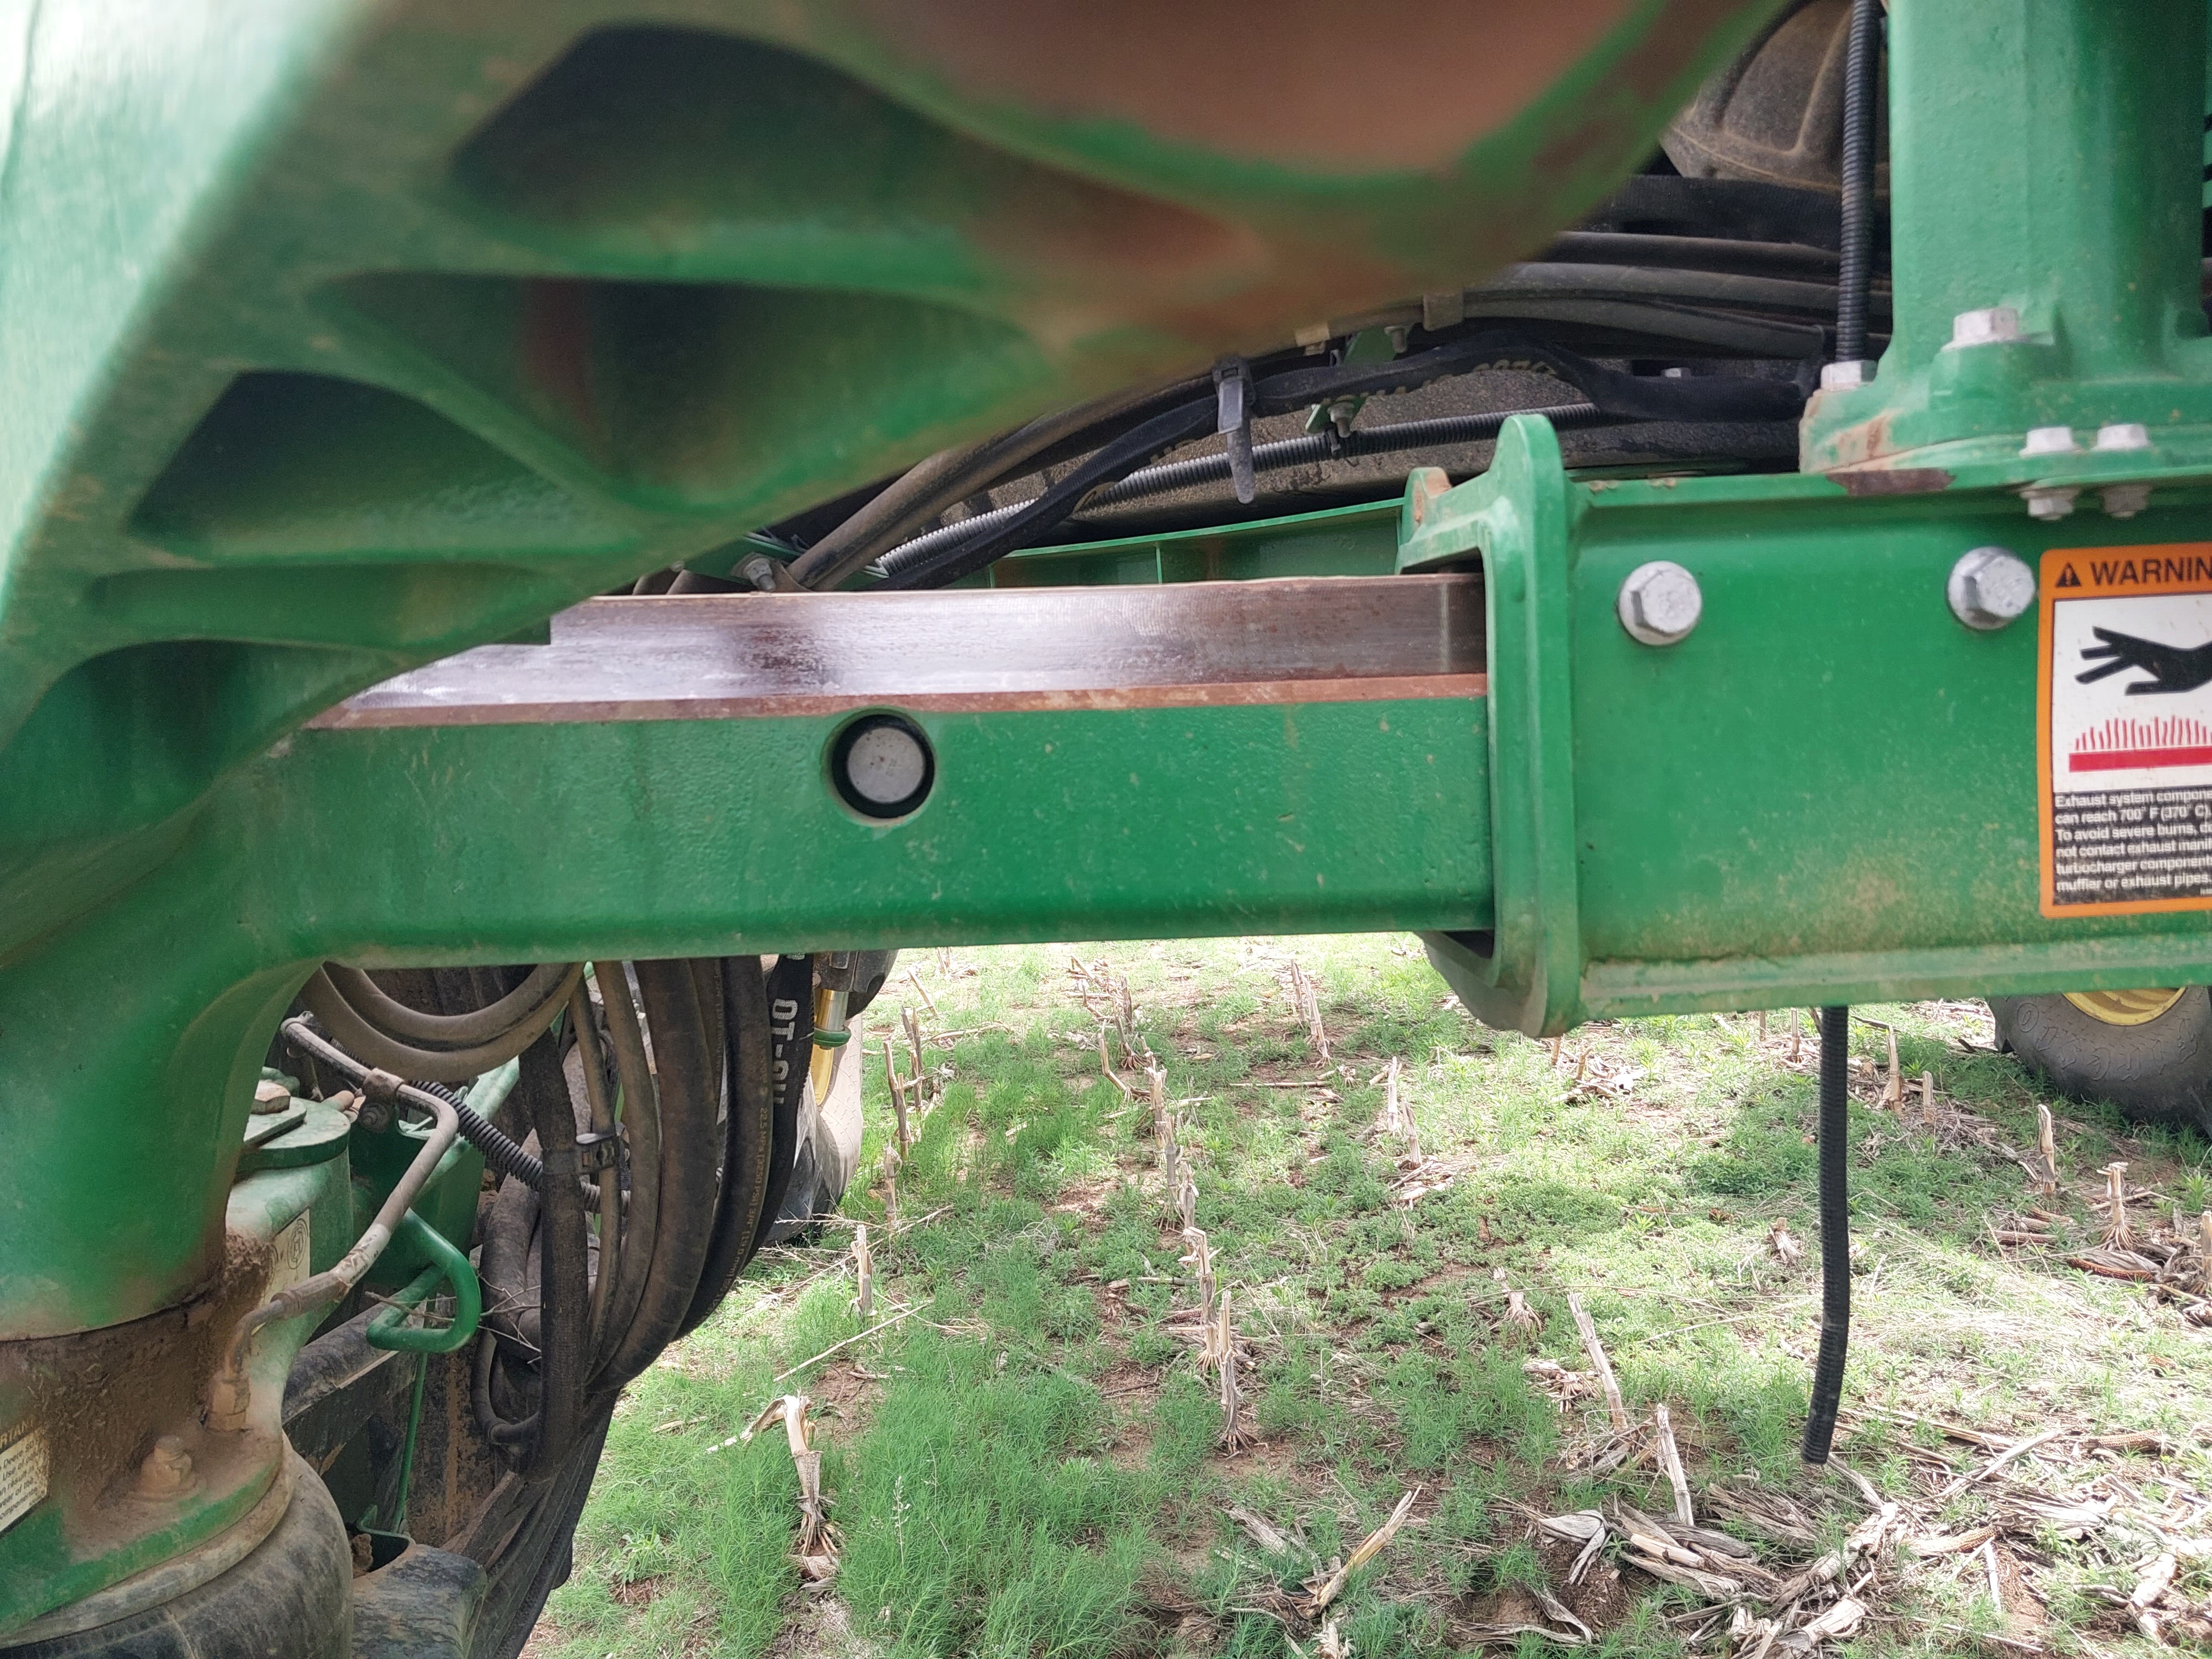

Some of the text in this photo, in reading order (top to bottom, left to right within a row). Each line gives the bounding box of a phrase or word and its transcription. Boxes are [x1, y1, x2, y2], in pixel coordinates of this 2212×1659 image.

[2089, 557, 2212, 586] WARNIN
[2055, 789, 2212, 808] Exhaust system compone
[2055, 814, 2079, 825] can
[2081, 810, 2117, 824] reach
[2055, 829, 2073, 841] To
[2074, 826, 2110, 840] avoid
[2112, 825, 2155, 838] severe
[2157, 822, 2198, 836] burns,
[2056, 845, 2078, 858] not
[2079, 843, 2126, 857] contact
[2127, 840, 2177, 854] exhaust
[2056, 860, 2138, 874] turbocharger
[2056, 878, 2102, 892] muffler
[2105, 878, 2118, 889] or
[2121, 874, 2173, 889] exhaust
[2014, 1000, 2199, 1082] Firesto
[3, 1467, 17, 1481] Use
[0, 1487, 38, 1520] omponents
